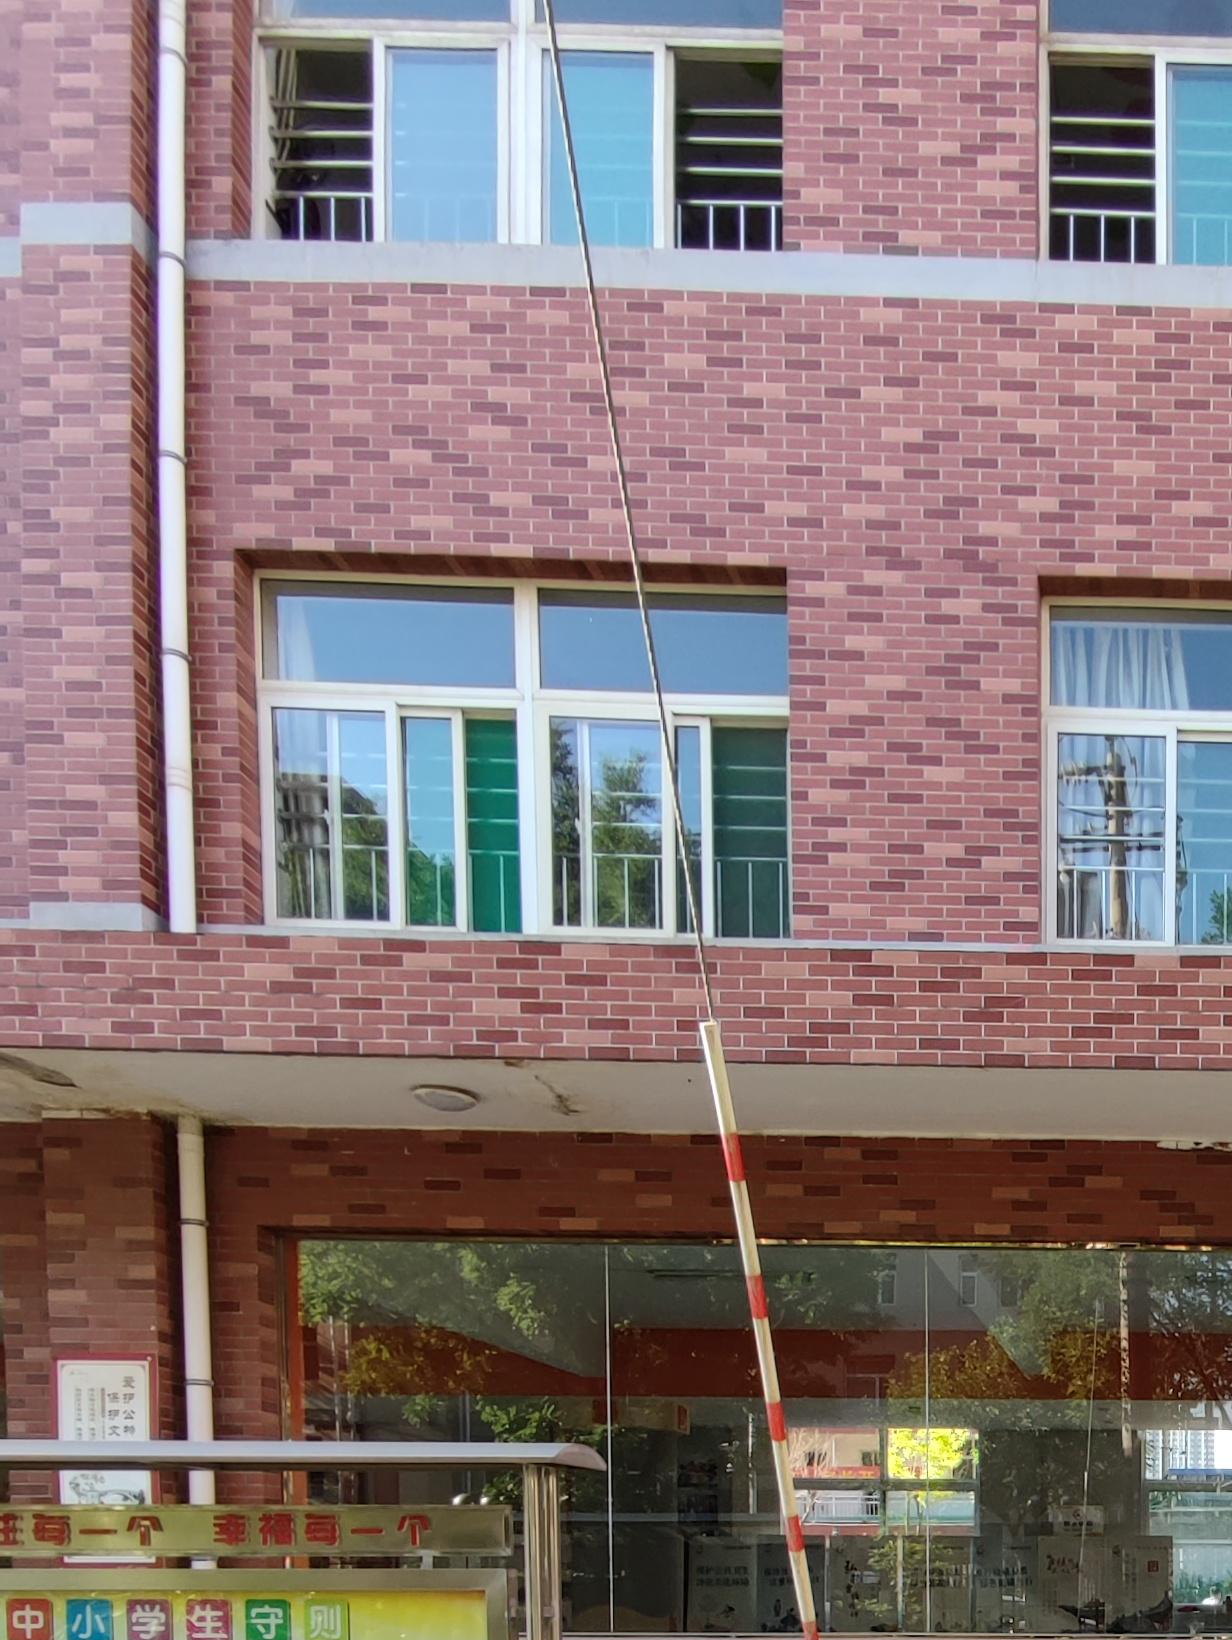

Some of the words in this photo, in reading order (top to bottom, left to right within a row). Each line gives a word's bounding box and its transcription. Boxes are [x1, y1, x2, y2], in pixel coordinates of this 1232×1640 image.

[213, 1513, 432, 1546] 幸福每一个
